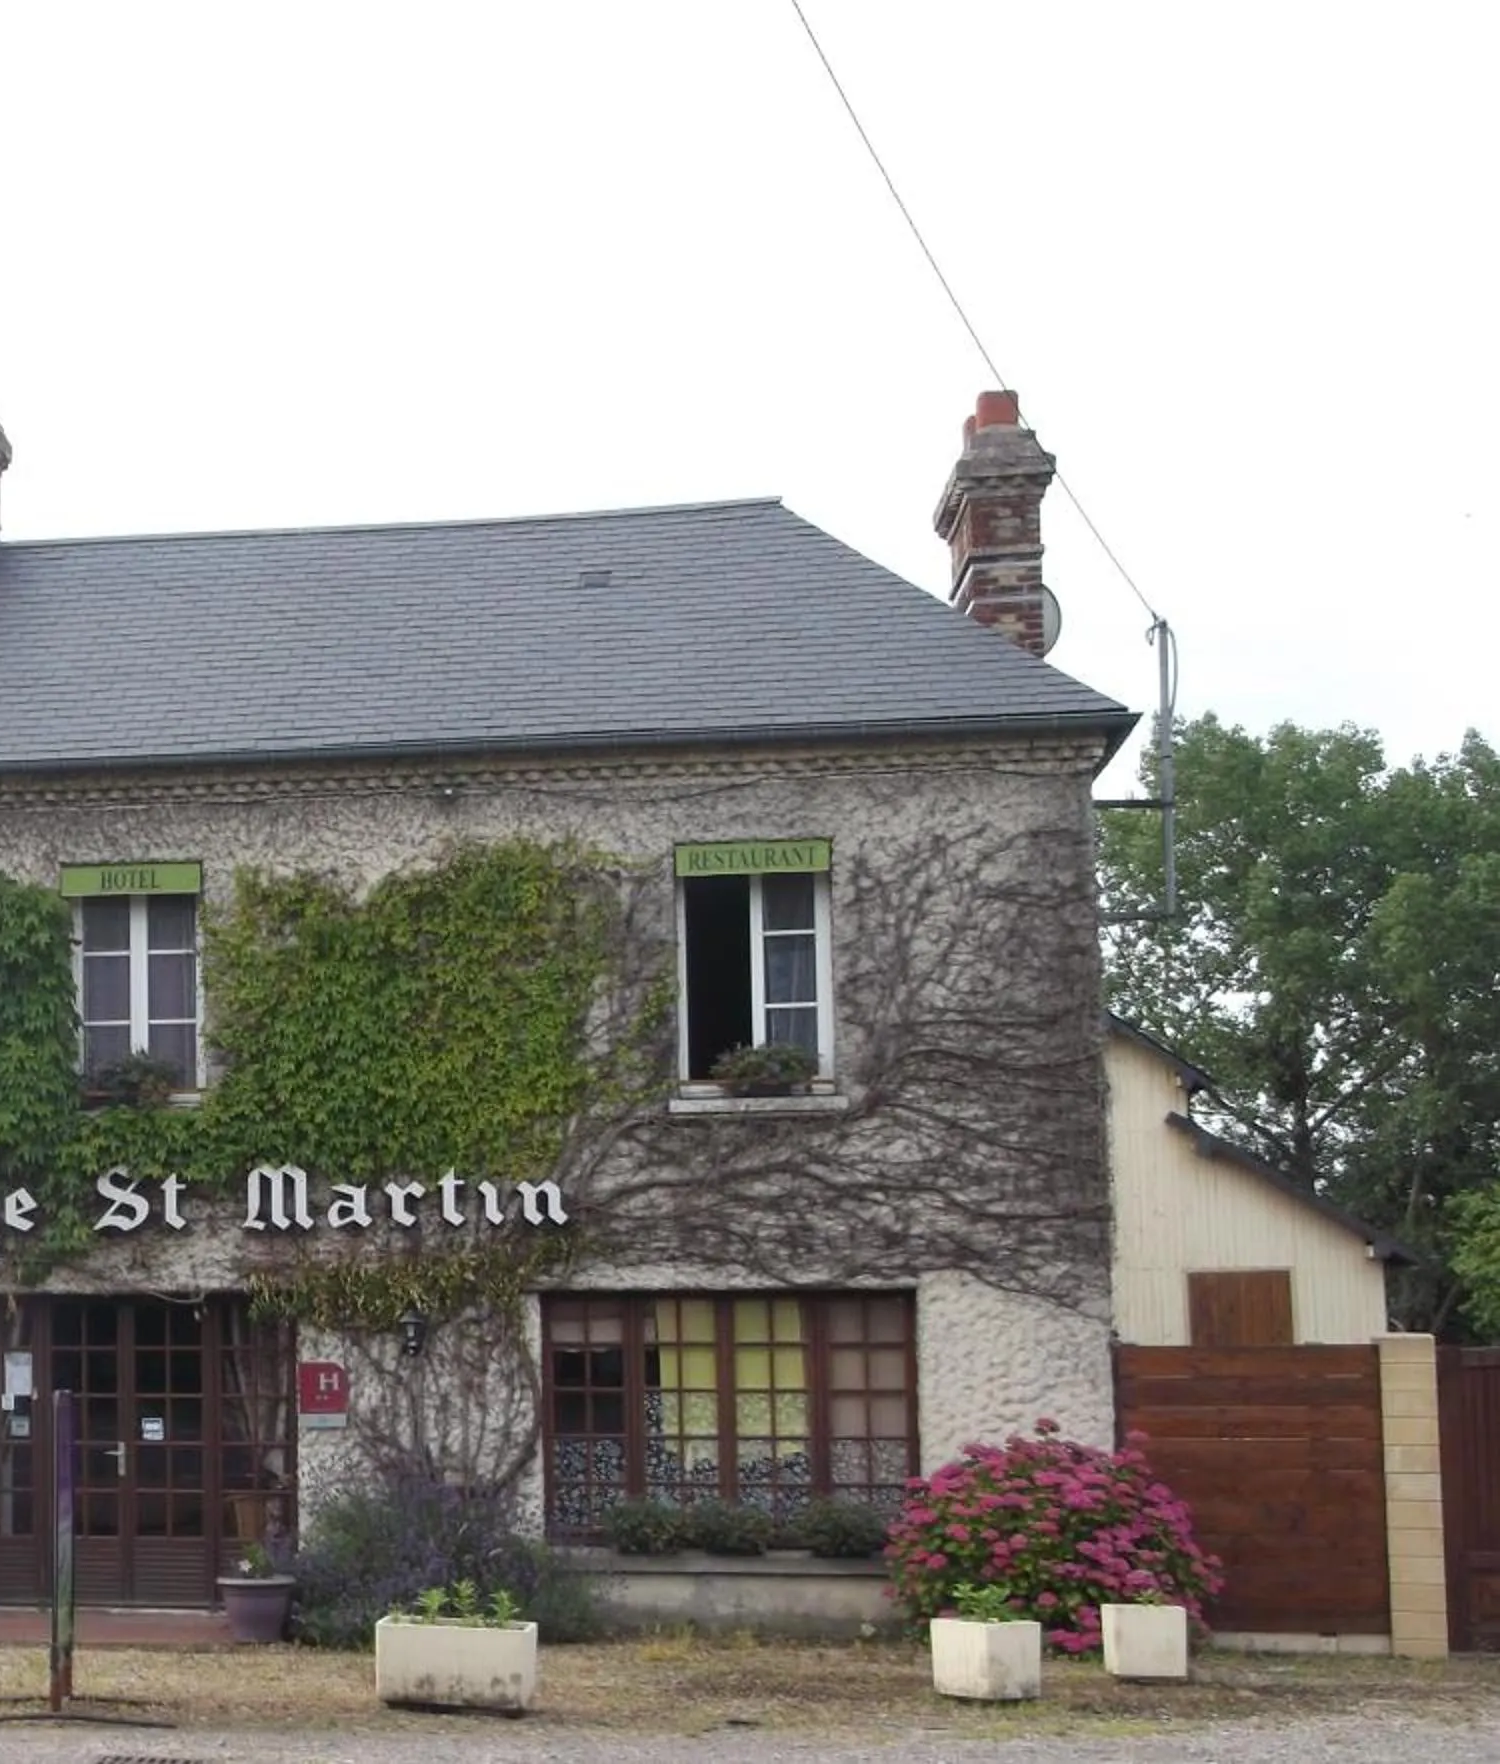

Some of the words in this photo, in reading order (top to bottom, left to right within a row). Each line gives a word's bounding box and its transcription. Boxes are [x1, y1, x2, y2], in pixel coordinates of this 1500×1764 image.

[687, 846, 816, 873] RESTAURANT
[100, 869, 161, 890] HOTEL
[92, 1163, 187, 1232] St
[241, 1162, 569, 1231] Martin
[319, 1372, 339, 1391] H
